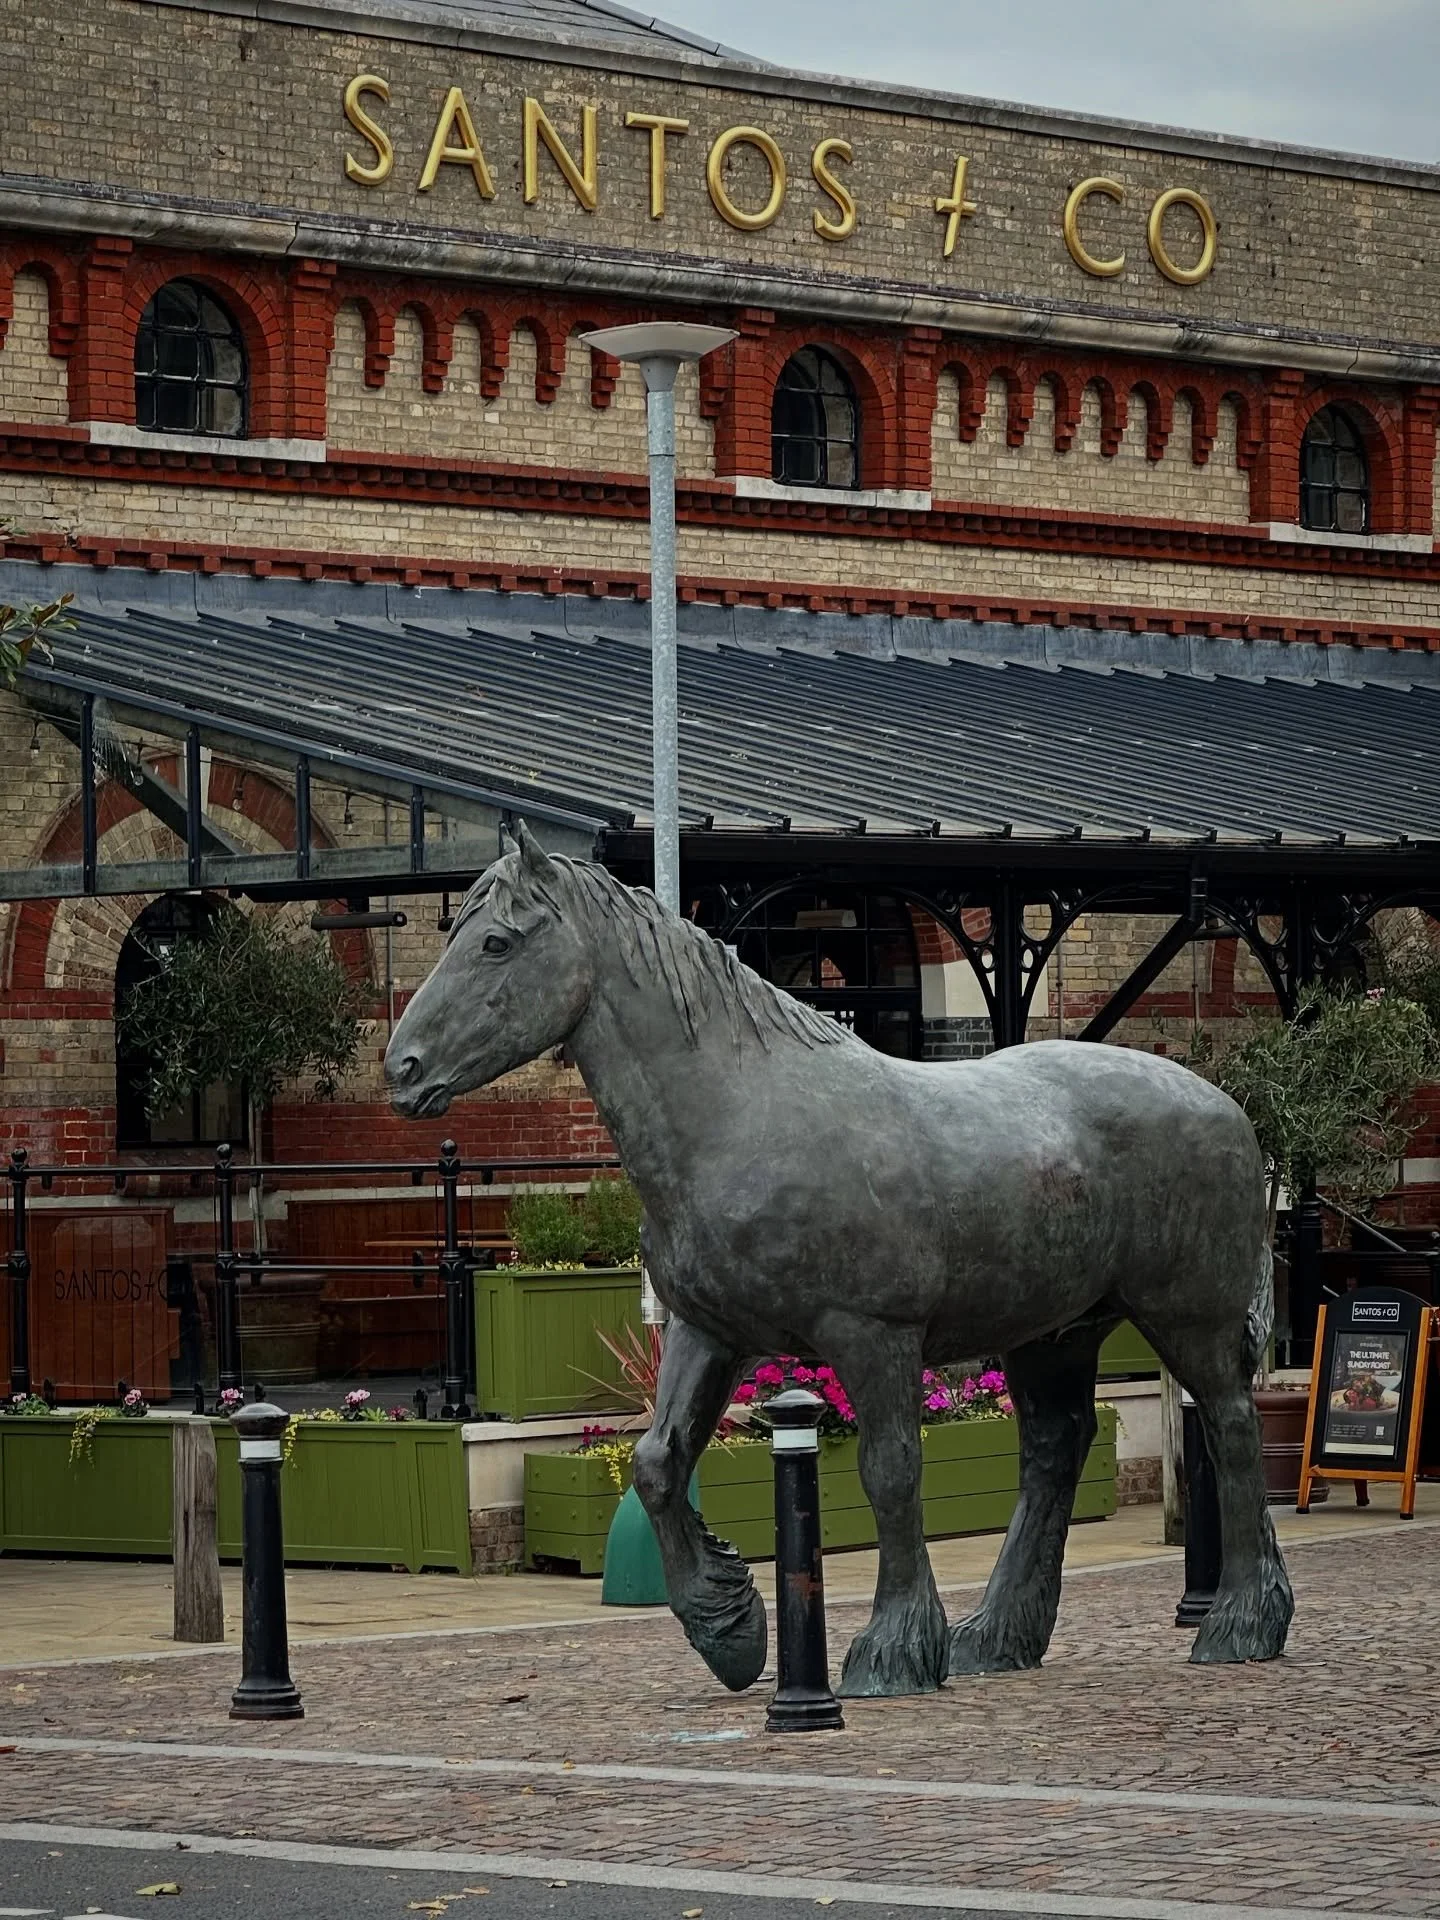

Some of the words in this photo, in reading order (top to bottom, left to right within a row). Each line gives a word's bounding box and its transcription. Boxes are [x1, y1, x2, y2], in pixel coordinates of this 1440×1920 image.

[343, 73, 857, 242] SANTOS
[1063, 175, 1217, 286] CO
[54, 1269, 142, 1301] SANTOS
[1354, 1308, 1382, 1316] SANTOS
[1387, 1308, 1397, 1316] CO
[1350, 1351, 1361, 1359] THE
[1361, 1351, 1390, 1360] ULTIMATE
[1347, 1360, 1370, 1369] SUNDAY
[1370, 1361, 1391, 1369] ROAST
